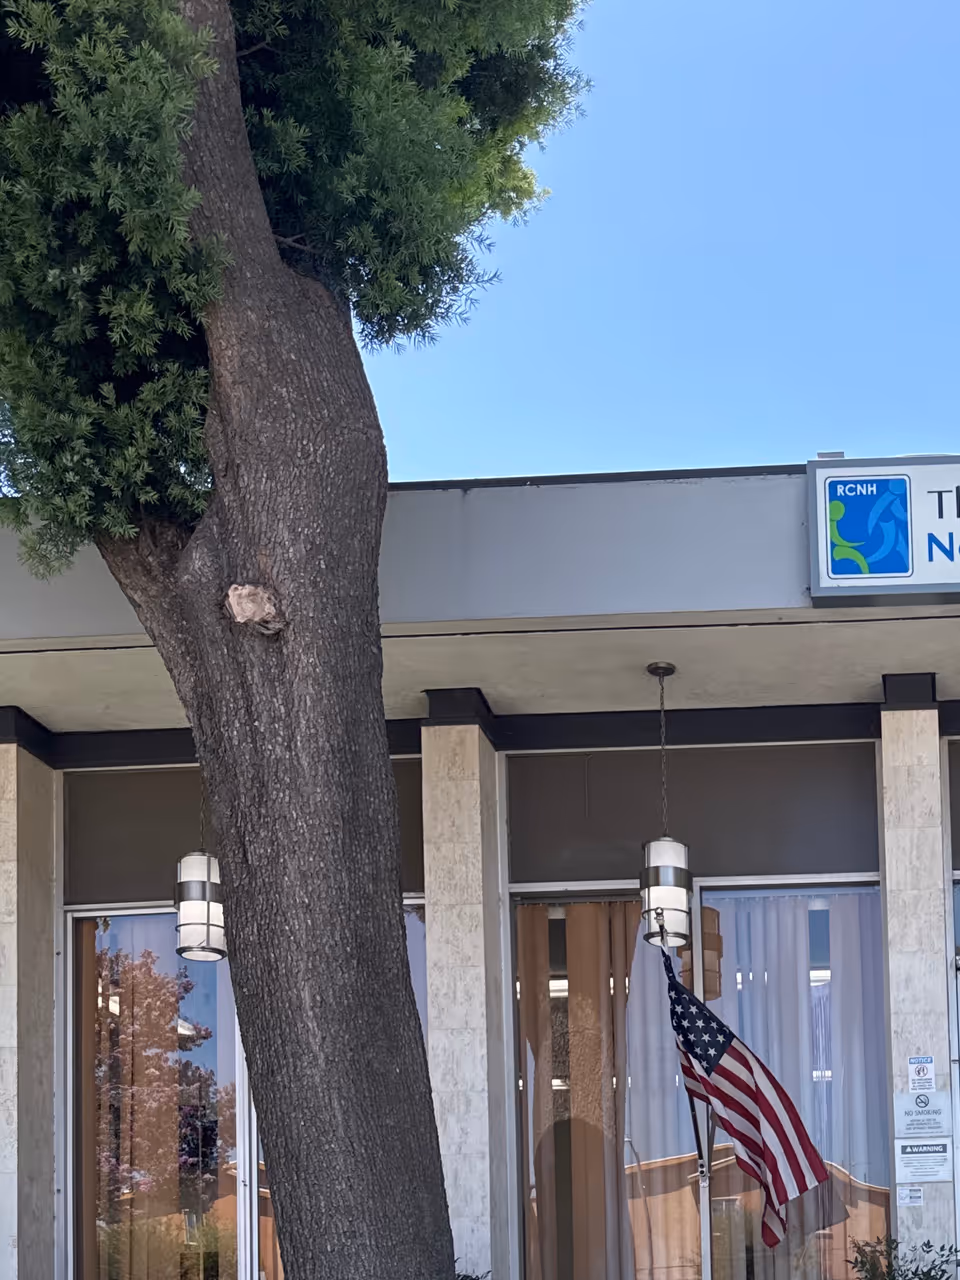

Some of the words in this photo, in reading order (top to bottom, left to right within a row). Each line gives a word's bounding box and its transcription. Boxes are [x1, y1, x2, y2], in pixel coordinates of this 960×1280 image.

[837, 483, 877, 496] RCNH
[904, 1109, 914, 1117] NO
[914, 1108, 942, 1117] SMOKING
[911, 1145, 943, 1153] WARNING
